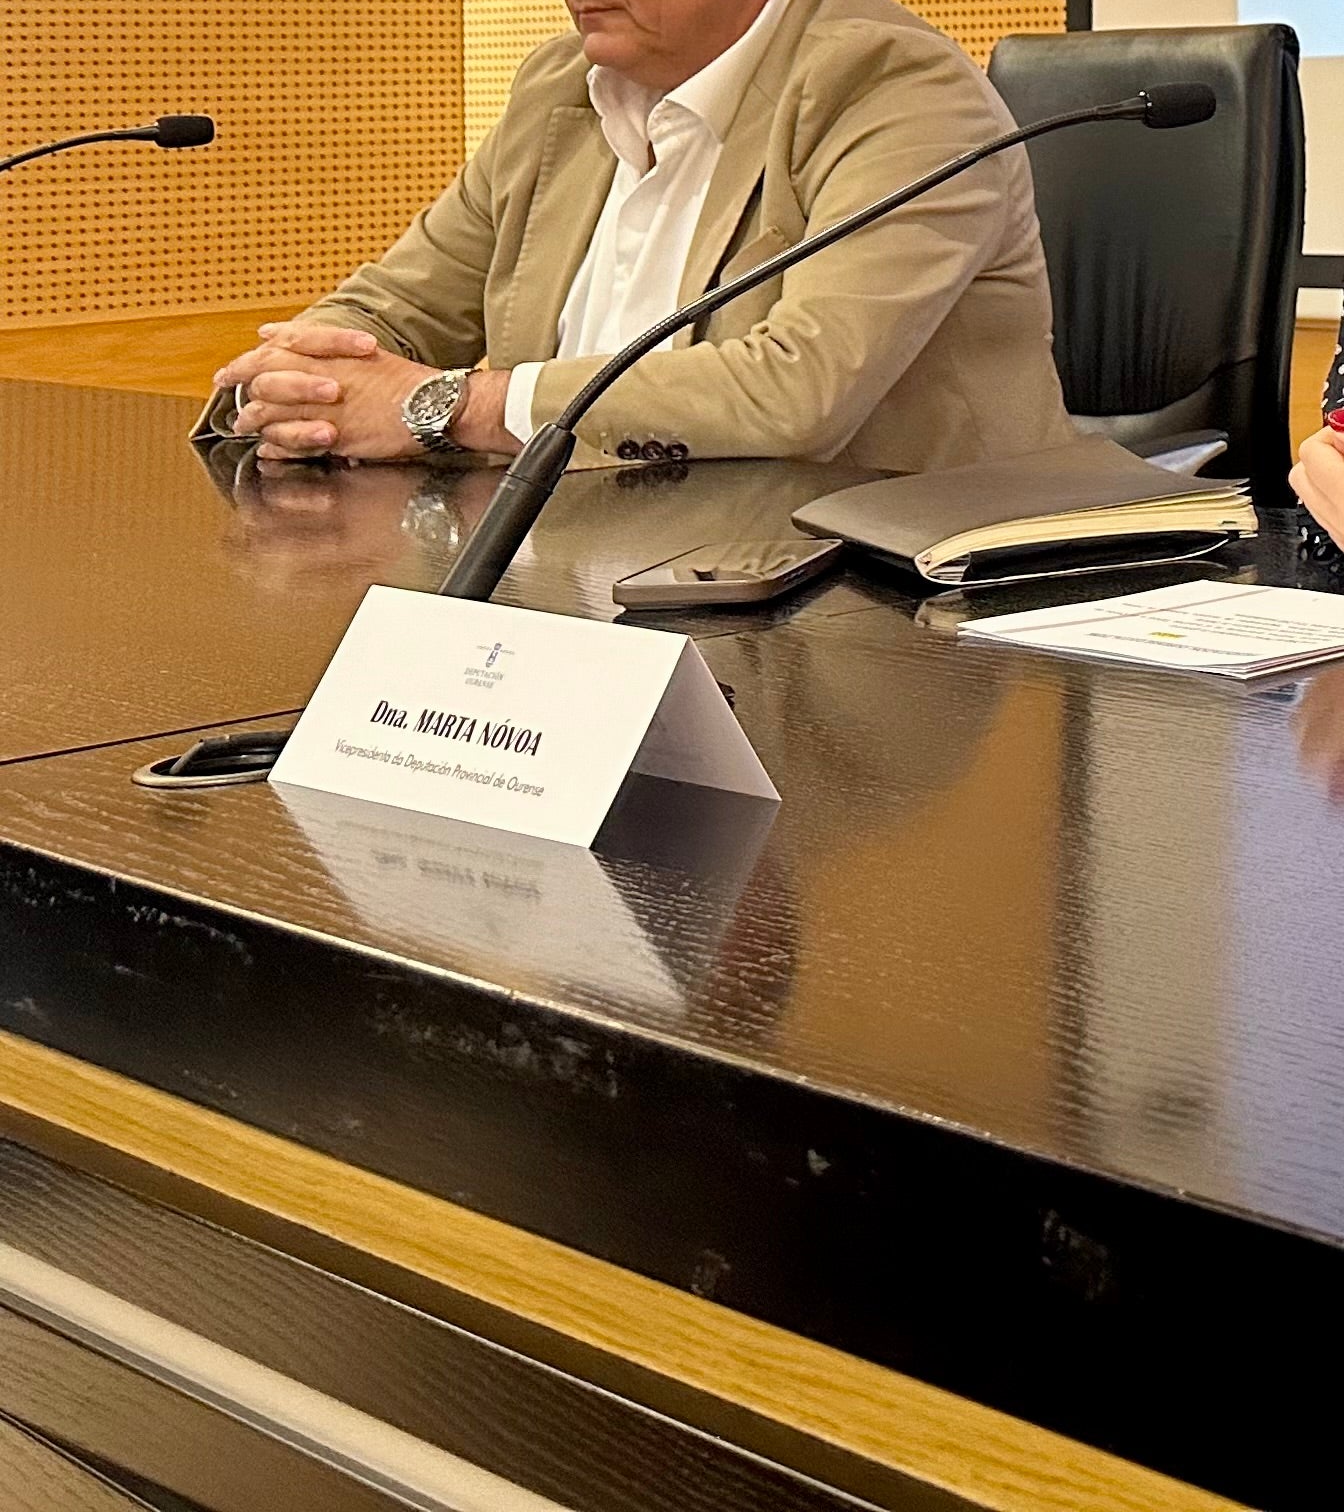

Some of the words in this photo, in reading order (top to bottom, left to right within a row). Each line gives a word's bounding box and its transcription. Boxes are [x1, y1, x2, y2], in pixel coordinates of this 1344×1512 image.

[370, 699, 408, 730] Dna.
[412, 708, 478, 743] MARTA
[476, 718, 543, 756] NÓVOA
[334, 737, 390, 764] Vicepresidenta
[404, 753, 452, 777] Deputación
[451, 763, 496, 785] Provincial
[492, 774, 506, 788] de
[506, 776, 545, 797] Ourense
